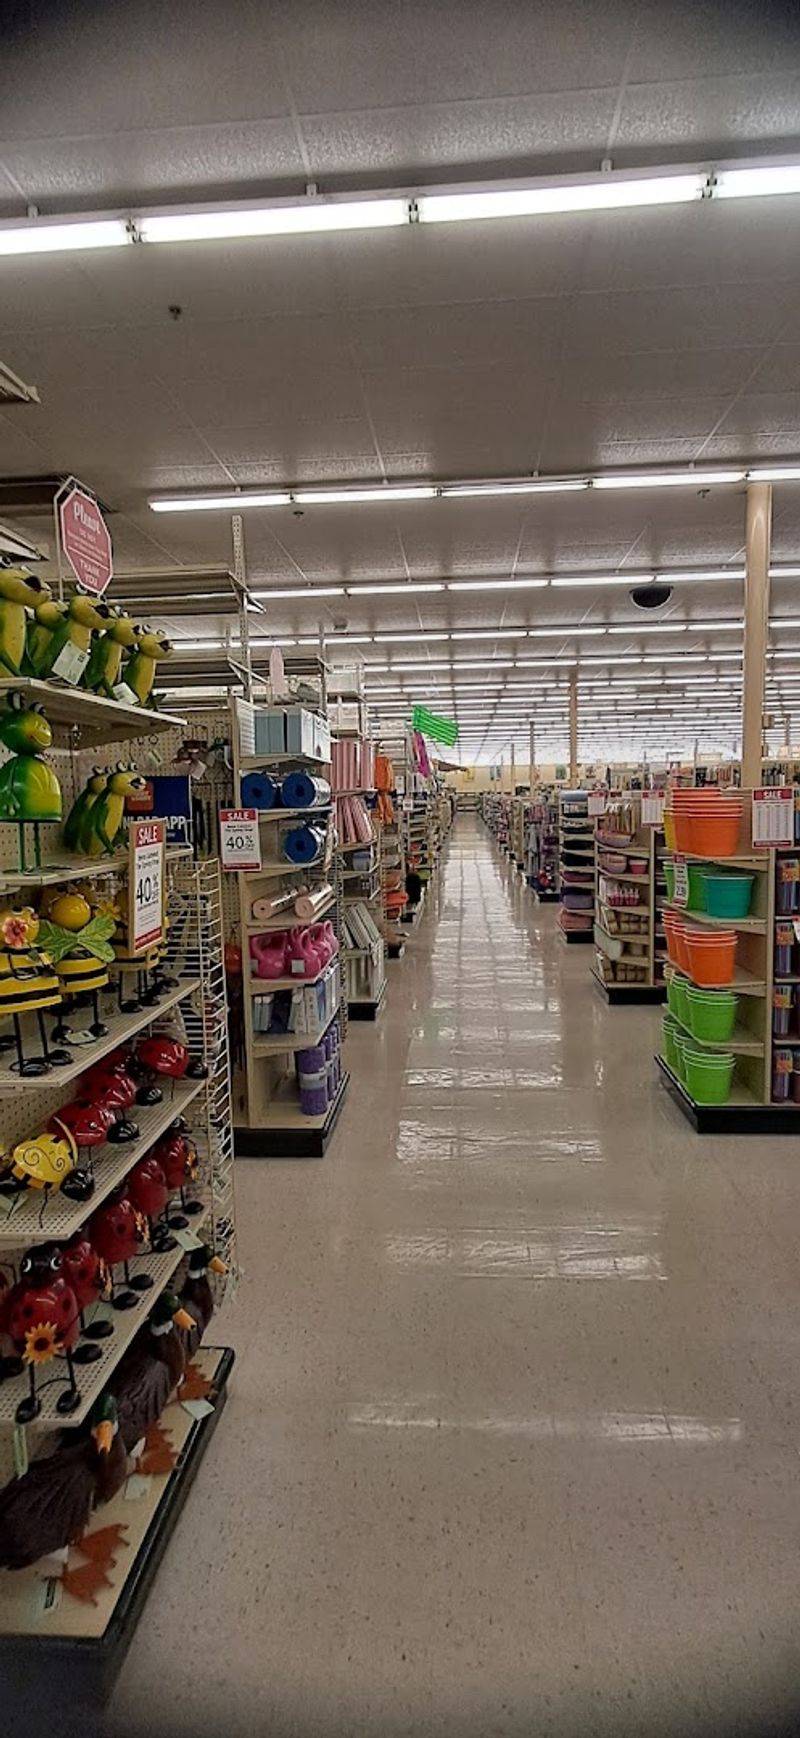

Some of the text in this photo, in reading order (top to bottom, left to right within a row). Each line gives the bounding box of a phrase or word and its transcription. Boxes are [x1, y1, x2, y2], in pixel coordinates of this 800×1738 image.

[763, 790, 783, 800] SALE
[227, 811, 250, 821] SALE
[164, 815, 187, 830] APP
[138, 825, 158, 846] SALE
